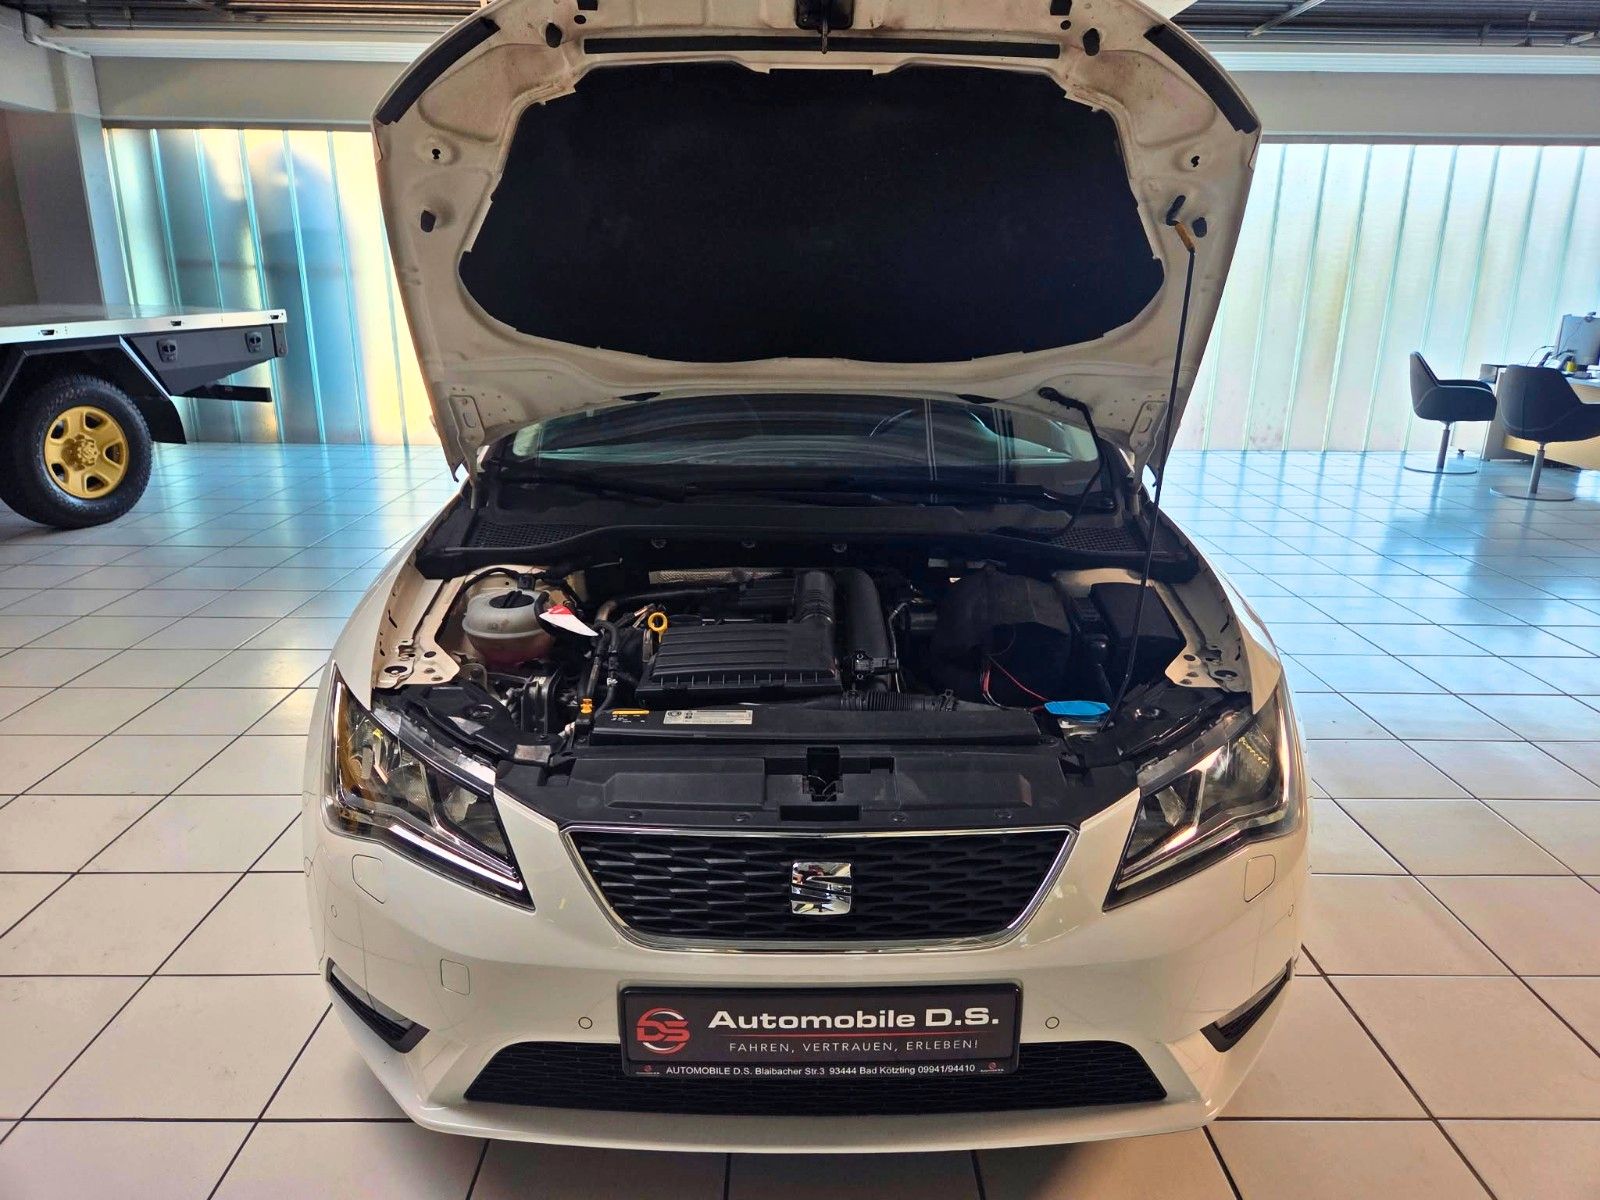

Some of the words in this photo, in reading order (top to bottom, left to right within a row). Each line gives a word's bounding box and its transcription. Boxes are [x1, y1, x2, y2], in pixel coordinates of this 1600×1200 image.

[707, 1010, 916, 1030] Automobile
[925, 1007, 1000, 1027] D.S.
[729, 1042, 795, 1054] FAHREN,
[802, 1041, 899, 1053] VERTRAUEN,
[906, 1039, 979, 1051] ERLEBEN!
[666, 1066, 731, 1076] AUTOMOBILE
[732, 1066, 753, 1076] D.S.
[755, 1066, 802, 1076] Blaibacher
[804, 1066, 825, 1075] Str.3
[828, 1066, 857, 1076] 93444
[859, 1065, 878, 1075] Bad
[879, 1064, 915, 1076] Kötzting
[917, 1064, 976, 1075] 09941/94410
